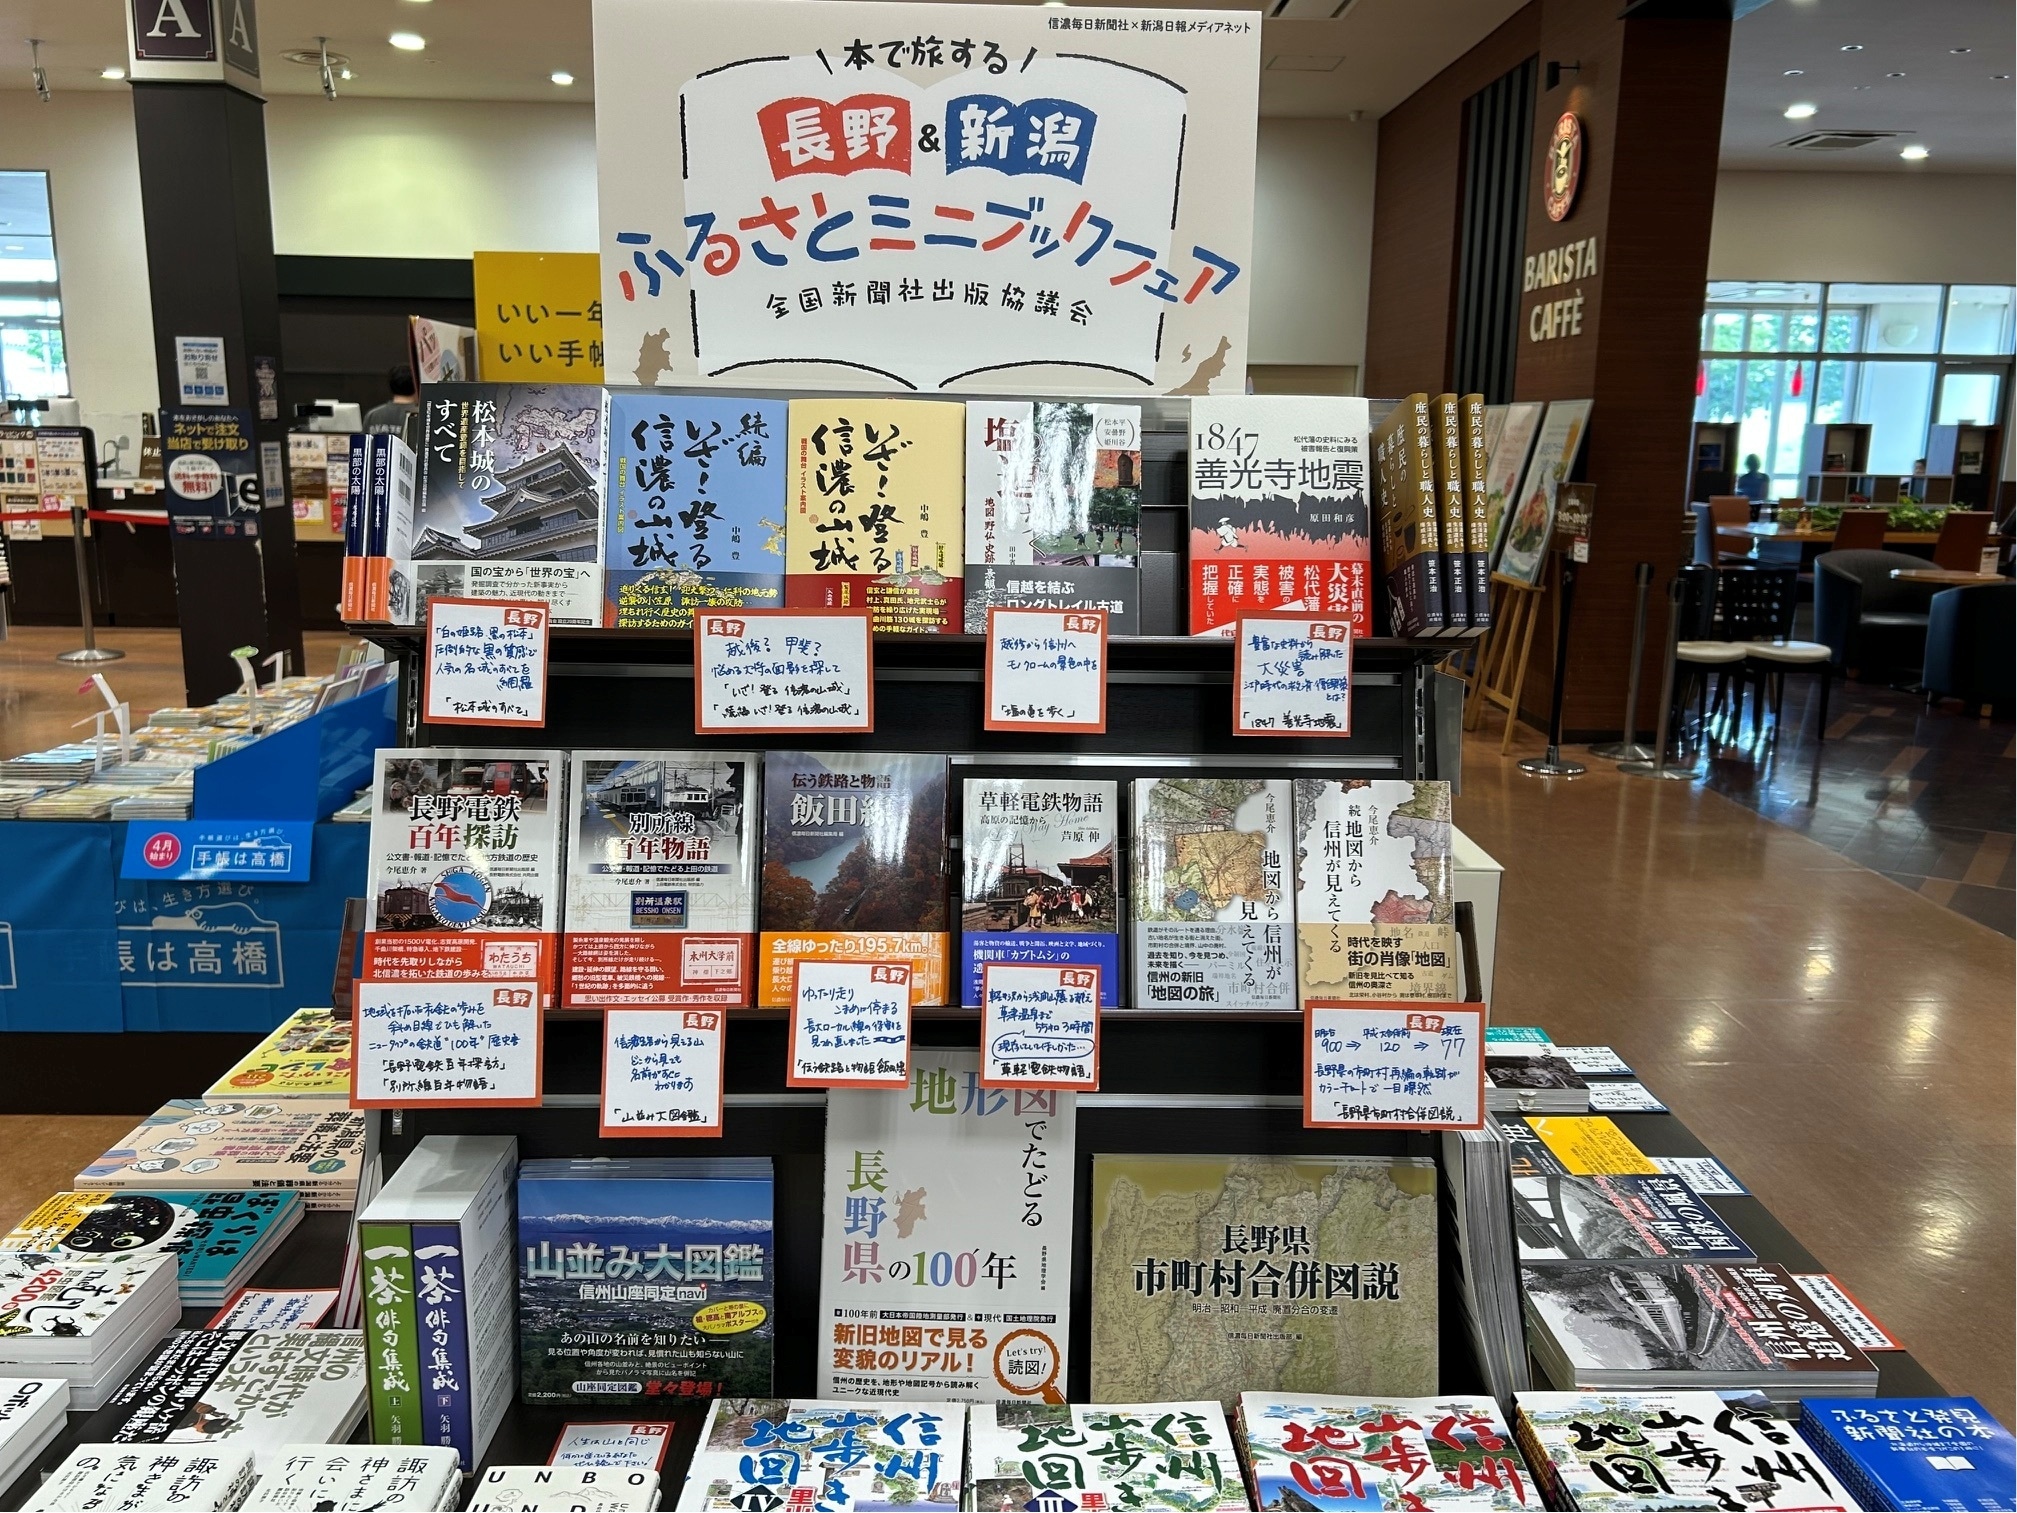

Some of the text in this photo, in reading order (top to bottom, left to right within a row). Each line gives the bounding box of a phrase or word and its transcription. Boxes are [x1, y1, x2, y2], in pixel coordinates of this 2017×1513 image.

[229, 3, 254, 53] A
[1048, 16, 1252, 35] 信濃毎日新聞社×新潟日報メディアネット
[844, 36, 1011, 75] 本で旅する
[780, 103, 1082, 170] 長野 & 新潟
[616, 191, 1241, 306] ふるさとミニブックフェア
[1523, 237, 1598, 293] BARISTA
[765, 276, 1094, 326] 全国新聞社出版協議会
[1529, 289, 1584, 342] CAFFÈ
[167, 437, 249, 451] 当店で受け取り
[174, 423, 240, 436] ネットで注文
[434, 399, 458, 463] すべて
[470, 400, 497, 491] 松本城の
[737, 411, 769, 467] 続編
[1195, 422, 1260, 460] 1847
[1293, 435, 1358, 445] 松代藩の史料にみる
[1301, 445, 1358, 454] 被害報告と復興策
[1415, 402, 1434, 519] 庶民の暮らしと職人史
[1444, 402, 1461, 519] 庶民の暮らしと職人史
[1470, 402, 1486, 519] 庶民の暮らしと職人史
[350, 448, 363, 496] 黒部の太陽
[374, 448, 386, 496] 黒部の太陽
[1195, 457, 1365, 492] 善光寺地震
[628, 413, 678, 567] 信濃の山城
[810, 417, 859, 572] 信濃の山城
[1309, 512, 1355, 524] 原田和彦
[471, 566, 590, 578] 国の宝から「世界の宝」へ
[1006, 580, 1075, 595] 信越を結ぶ
[1227, 565, 1244, 603] 正確に
[1253, 565, 1270, 604] 実態を
[1278, 565, 1296, 603] 被害の
[1428, 559, 1438, 593] 笹本正治
[1453, 559, 1462, 593] 笹本正治
[1477, 559, 1486, 593] 笹本正治
[1202, 564, 1219, 625] 把握していた
[1351, 562, 1364, 624] 幕末直前の
[506, 610, 539, 626] 長野
[710, 621, 741, 635] 長野
[1065, 616, 1098, 632] 長野
[1312, 626, 1342, 641] 長野
[408, 795, 521, 823] 長野電鉄
[978, 791, 1104, 813] 草軽電鉄物語
[1265, 793, 1276, 834] 今尾恵介
[408, 822, 518, 850] 百年探訪
[629, 812, 695, 834] 別所線
[980, 814, 1047, 826] 高原の記憶から
[1368, 805, 1379, 846] 今尾恵介
[152, 840, 173, 851] 4月
[1061, 830, 1100, 843] 芦原 伸
[150, 851, 174, 861] 始まり
[197, 850, 285, 867] 手帳は高橋
[386, 866, 418, 875] 今尾恵介
[615, 878, 643, 886] 今尾恵介
[1323, 821, 1343, 954] 信州が見えてくる
[488, 951, 532, 964] わたうち
[772, 936, 929, 955] 全線ゆったり195.7km。
[973, 949, 1070, 961] 機関車「カブトムシ」の
[1240, 901, 1259, 988] 見えてくる
[1348, 937, 1403, 948] 時代を映す
[373, 957, 463, 967] 時代を先取りしながら
[874, 967, 905, 982] 長野
[1348, 951, 1451, 968] 街の肖像「地図」
[1063, 972, 1092, 987] 長野
[1147, 971, 1204, 983] 信州の新旧
[1348, 972, 1415, 980] 新旧を見比べて知る
[495, 989, 530, 1006] 長野
[1147, 985, 1220, 1003] 「地図の旅」
[685, 1013, 716, 1028] 長野
[1409, 1016, 1440, 1030] 長野
[1321, 1038, 1465, 1060] 900 120 77
[910, 1066, 1056, 1117] 地形図
[1021, 1120, 1048, 1227] でたどる
[841, 1150, 889, 1284] 長野県
[1648, 1177, 1741, 1250] 国鉄の風景
[1220, 1224, 1311, 1255] 長野県
[526, 1241, 764, 1282] 山並み大図鑑
[579, 1285, 706, 1301] 信州山座同定 navi
[1132, 1257, 1400, 1301] 市町村合併図説
[363, 1244, 411, 1393] 一茶俳句集成
[413, 1243, 460, 1392] 一茶俳句集成
[1738, 1266, 1853, 1361] 追憶の列車
[833, 1323, 988, 1348] 新旧地図で見る
[1741, 1320, 1801, 1361] 信州
[548, 1348, 744, 1359] 見る位置や角度が変われば、見慣れた山も知らない山に
[833, 1349, 974, 1373] 変貌のリアル！
[1006, 1349, 1028, 1357] Let's
[576, 1382, 638, 1393] 山座同定図鑑
[832, 1377, 979, 1389] 信州の歴史を、地形や地図記号から読み解く
[832, 1387, 900, 1396] ユニークな近現代史
[632, 1426, 664, 1435] 長野
[1831, 1408, 1982, 1424] ふるさと発見
[1843, 1424, 1996, 1441] 新聞社の本
[739, 1419, 815, 1485] 地図
[875, 1412, 943, 1494] 信州
[1017, 1425, 1087, 1489] 地図
[1150, 1412, 1222, 1495] 信州
[1282, 1422, 1367, 1499] 地図
[1431, 1413, 1526, 1507] 信州
[1567, 1420, 1674, 1496] 地図
[1712, 1405, 1834, 1500] 信州
[167, 1457, 218, 1504] 諏訪の
[285, 1457, 315, 1486] 行く
[386, 1457, 429, 1504] 諏訪の
